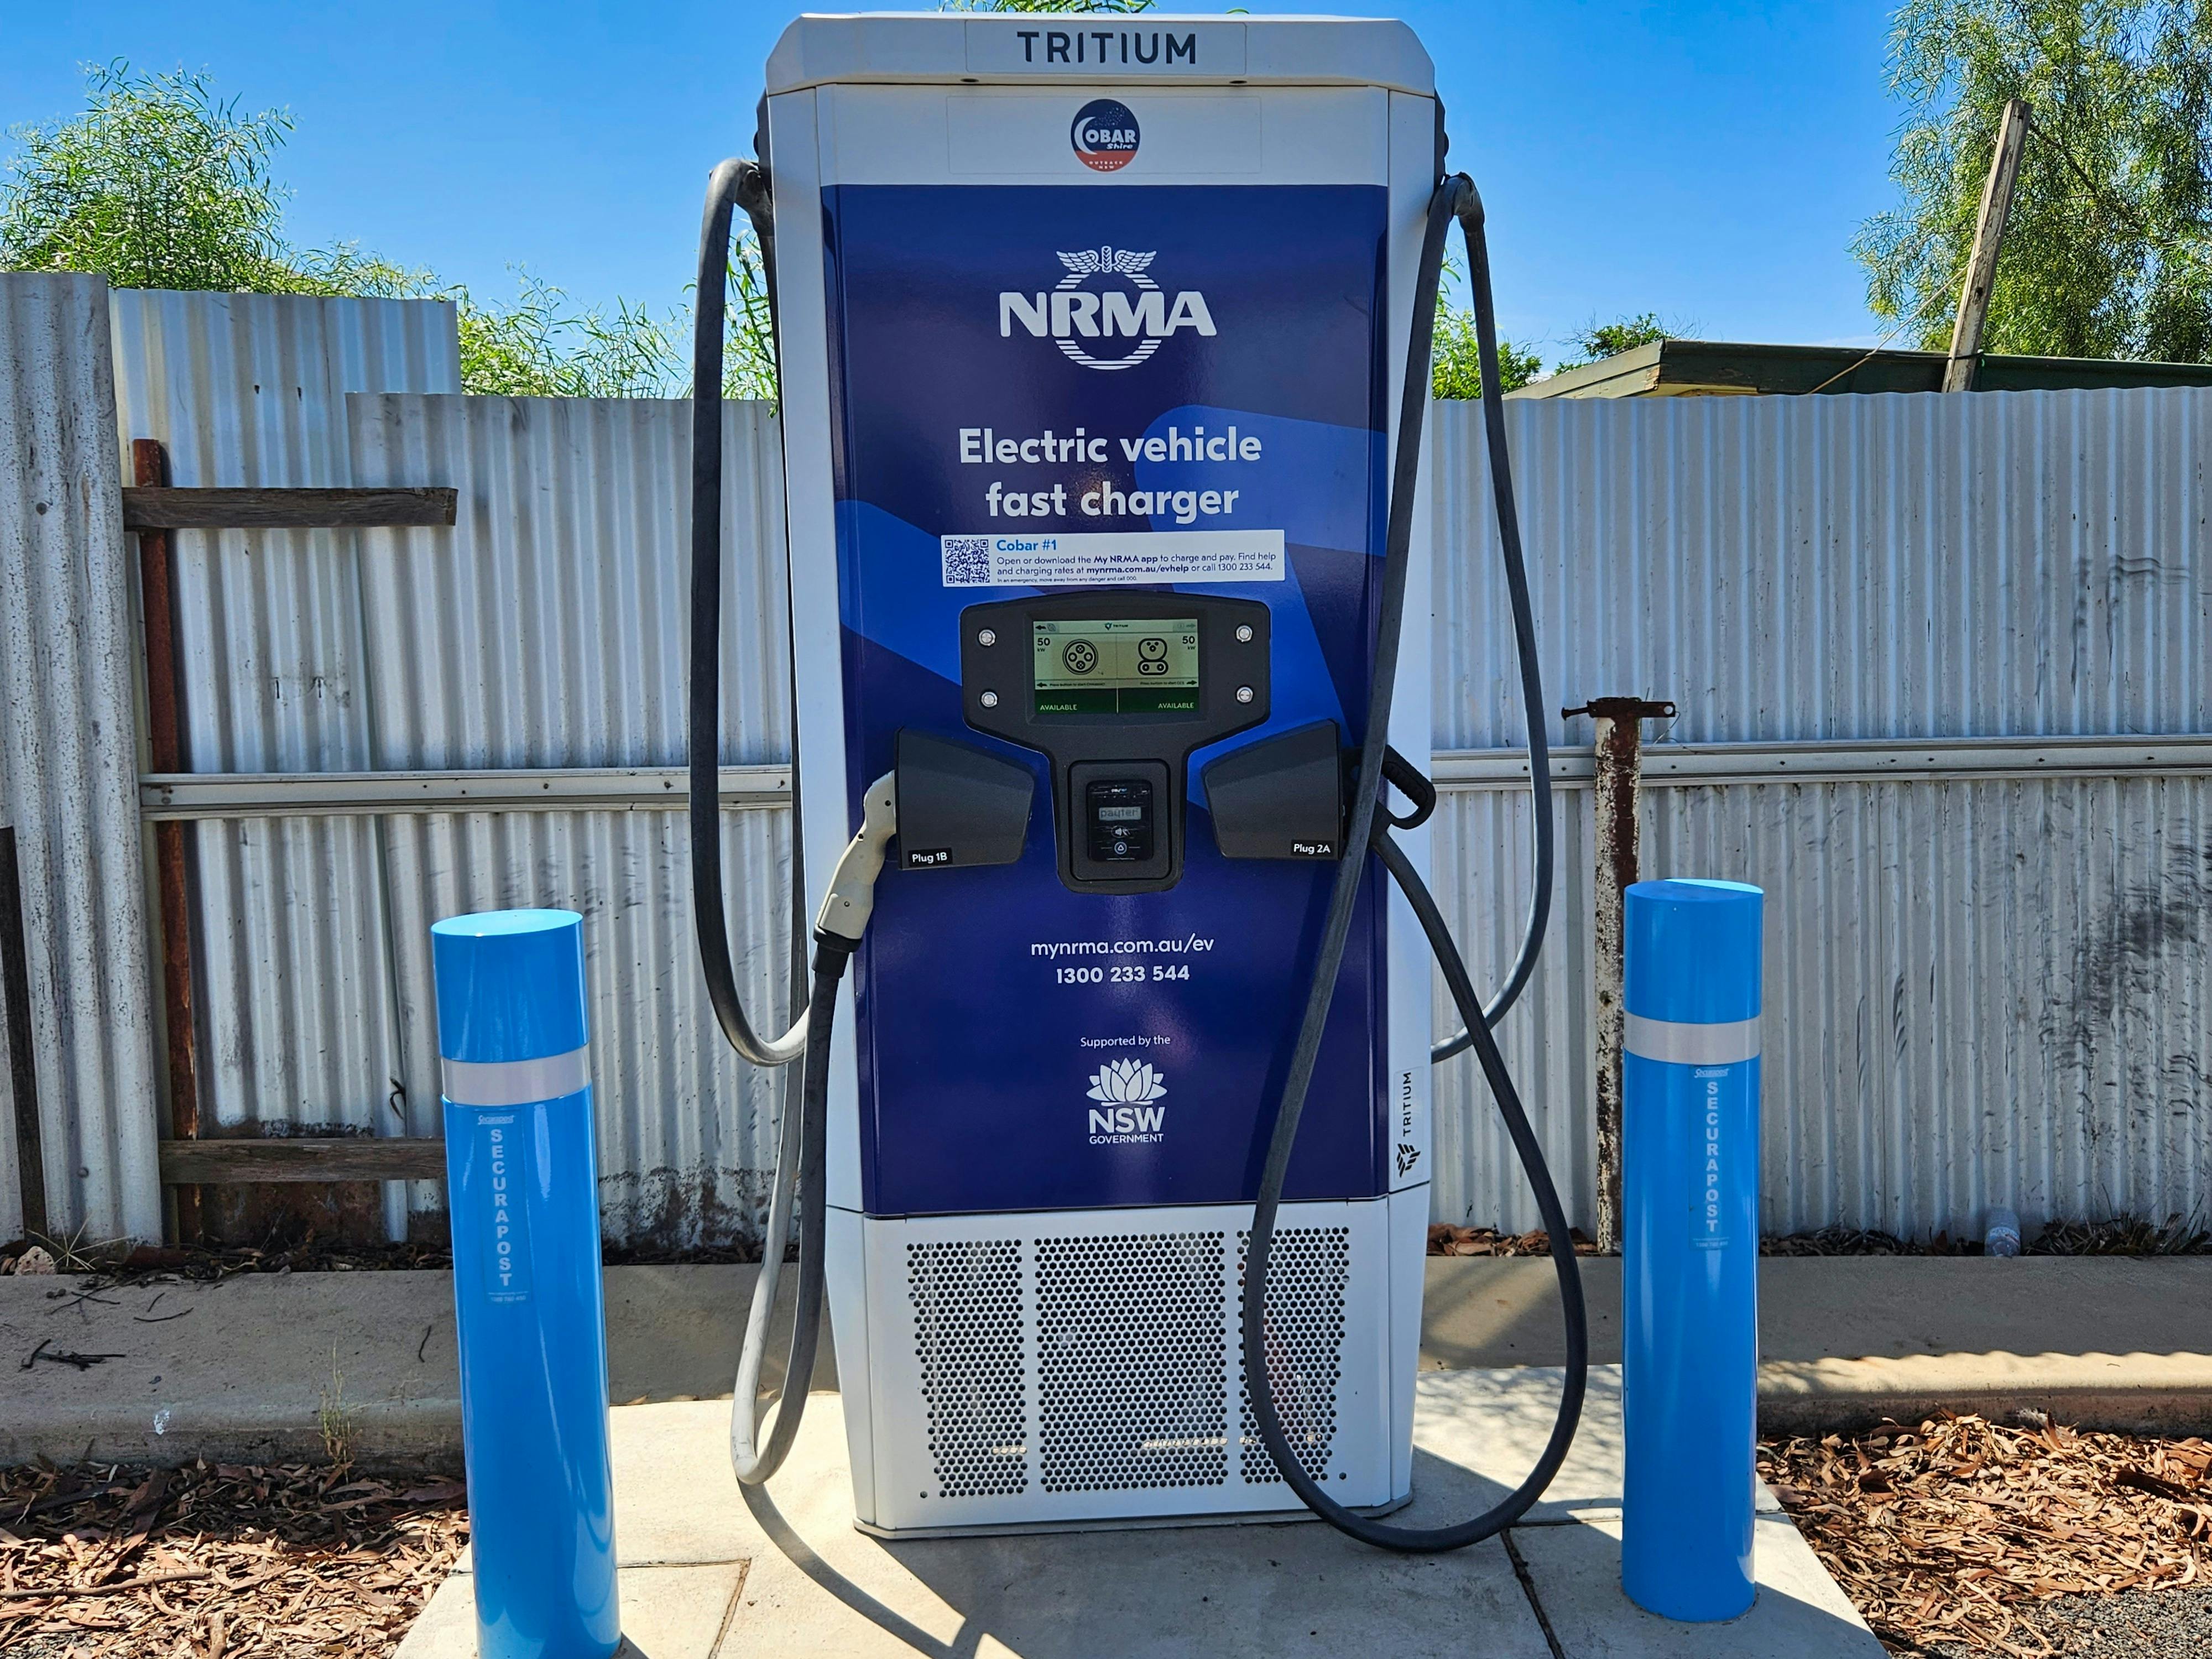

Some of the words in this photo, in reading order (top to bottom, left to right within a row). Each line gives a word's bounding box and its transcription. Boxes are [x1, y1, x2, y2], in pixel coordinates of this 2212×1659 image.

[1017, 31, 1196, 64] TRITIUM
[999, 291, 1217, 337] NRMA
[959, 427, 1108, 463] Electric
[1119, 426, 1262, 462] vehicle
[985, 482, 1067, 517] fast
[1080, 481, 1239, 524] charger
[997, 539, 1039, 551] Cobar
[1042, 539, 1057, 551] #1
[997, 556, 1021, 566] Open
[1034, 555, 1076, 564] download
[1078, 555, 1091, 564] the
[1094, 555, 1108, 565] My
[1110, 555, 1139, 563] NRMA
[1171, 553, 1199, 563] charge
[1201, 553, 1217, 561] and
[1219, 554, 1236, 562] pay.
[1238, 552, 1255, 561] Find
[1258, 552, 1276, 561] help
[997, 567, 1013, 575] and
[1015, 566, 1052, 576] charging
[1087, 564, 1189, 574] mynrma.com.au/evhelp
[1202, 563, 1216, 571] call
[1218, 563, 1237, 571] 1300
[1255, 562, 1272, 570] 544.
[1037, 638, 1051, 646] 50
[1182, 636, 1196, 644] 50
[1100, 808, 1139, 818] payter
[1293, 843, 1315, 854] Plug
[1317, 844, 1331, 853] 2A
[912, 853, 934, 864] Plug
[936, 852, 948, 862] 1B
[1031, 932, 1214, 959] mynrma.com.au/ev
[1056, 967, 1104, 984] 1300
[1110, 966, 1146, 983] 233
[1152, 964, 1190, 982] 544
[1080, 1035, 1136, 1049] Supported
[1138, 1035, 1151, 1047] by
[1153, 1035, 1171, 1045] the
[1403, 1072, 1411, 1137] TRITIUM
[1089, 1107, 1166, 1134] NSW
[1089, 1134, 1164, 1144] GOVERNMENT
[1705, 1081, 1719, 1232] SECURAPOST
[491, 1129, 512, 1286] SECURAPOST
